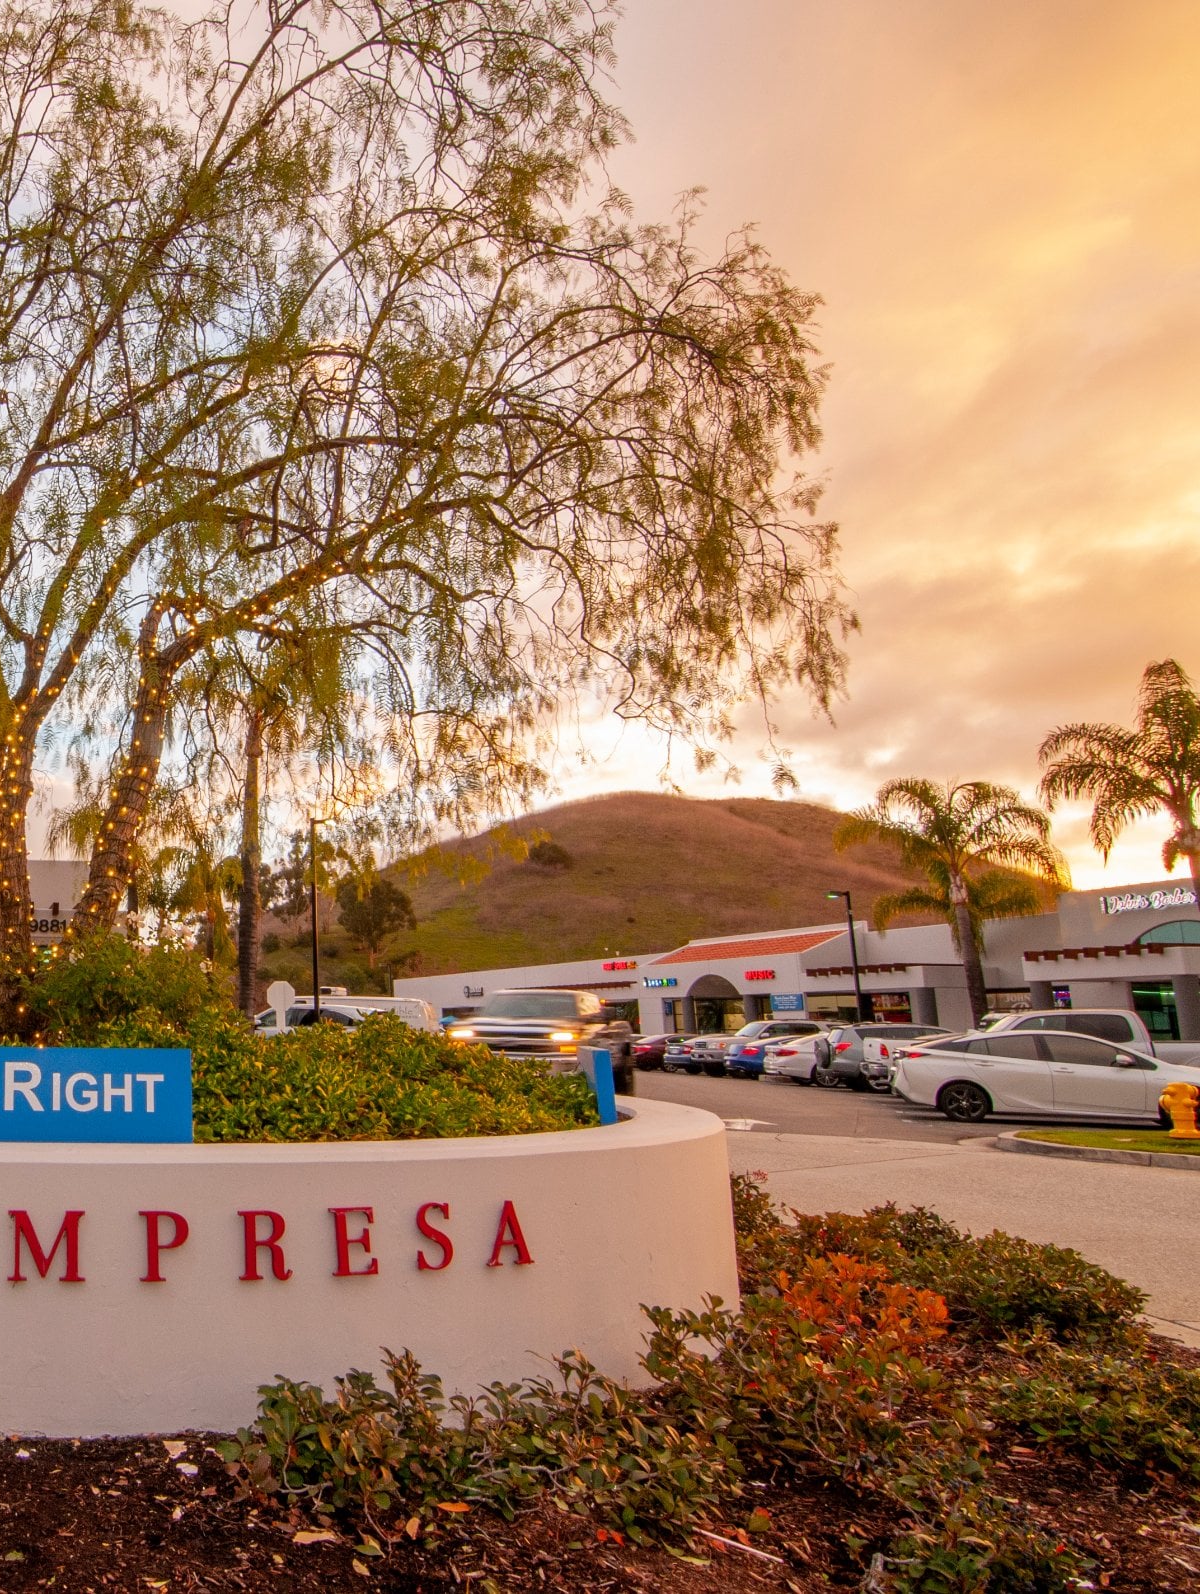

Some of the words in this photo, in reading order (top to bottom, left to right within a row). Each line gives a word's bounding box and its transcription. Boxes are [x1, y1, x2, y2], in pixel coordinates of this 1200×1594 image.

[1108, 893, 1150, 914] John's
[1150, 887, 1197, 909] Barber
[744, 969, 775, 981] MUSIC
[3, 1061, 165, 1113] RIGHT
